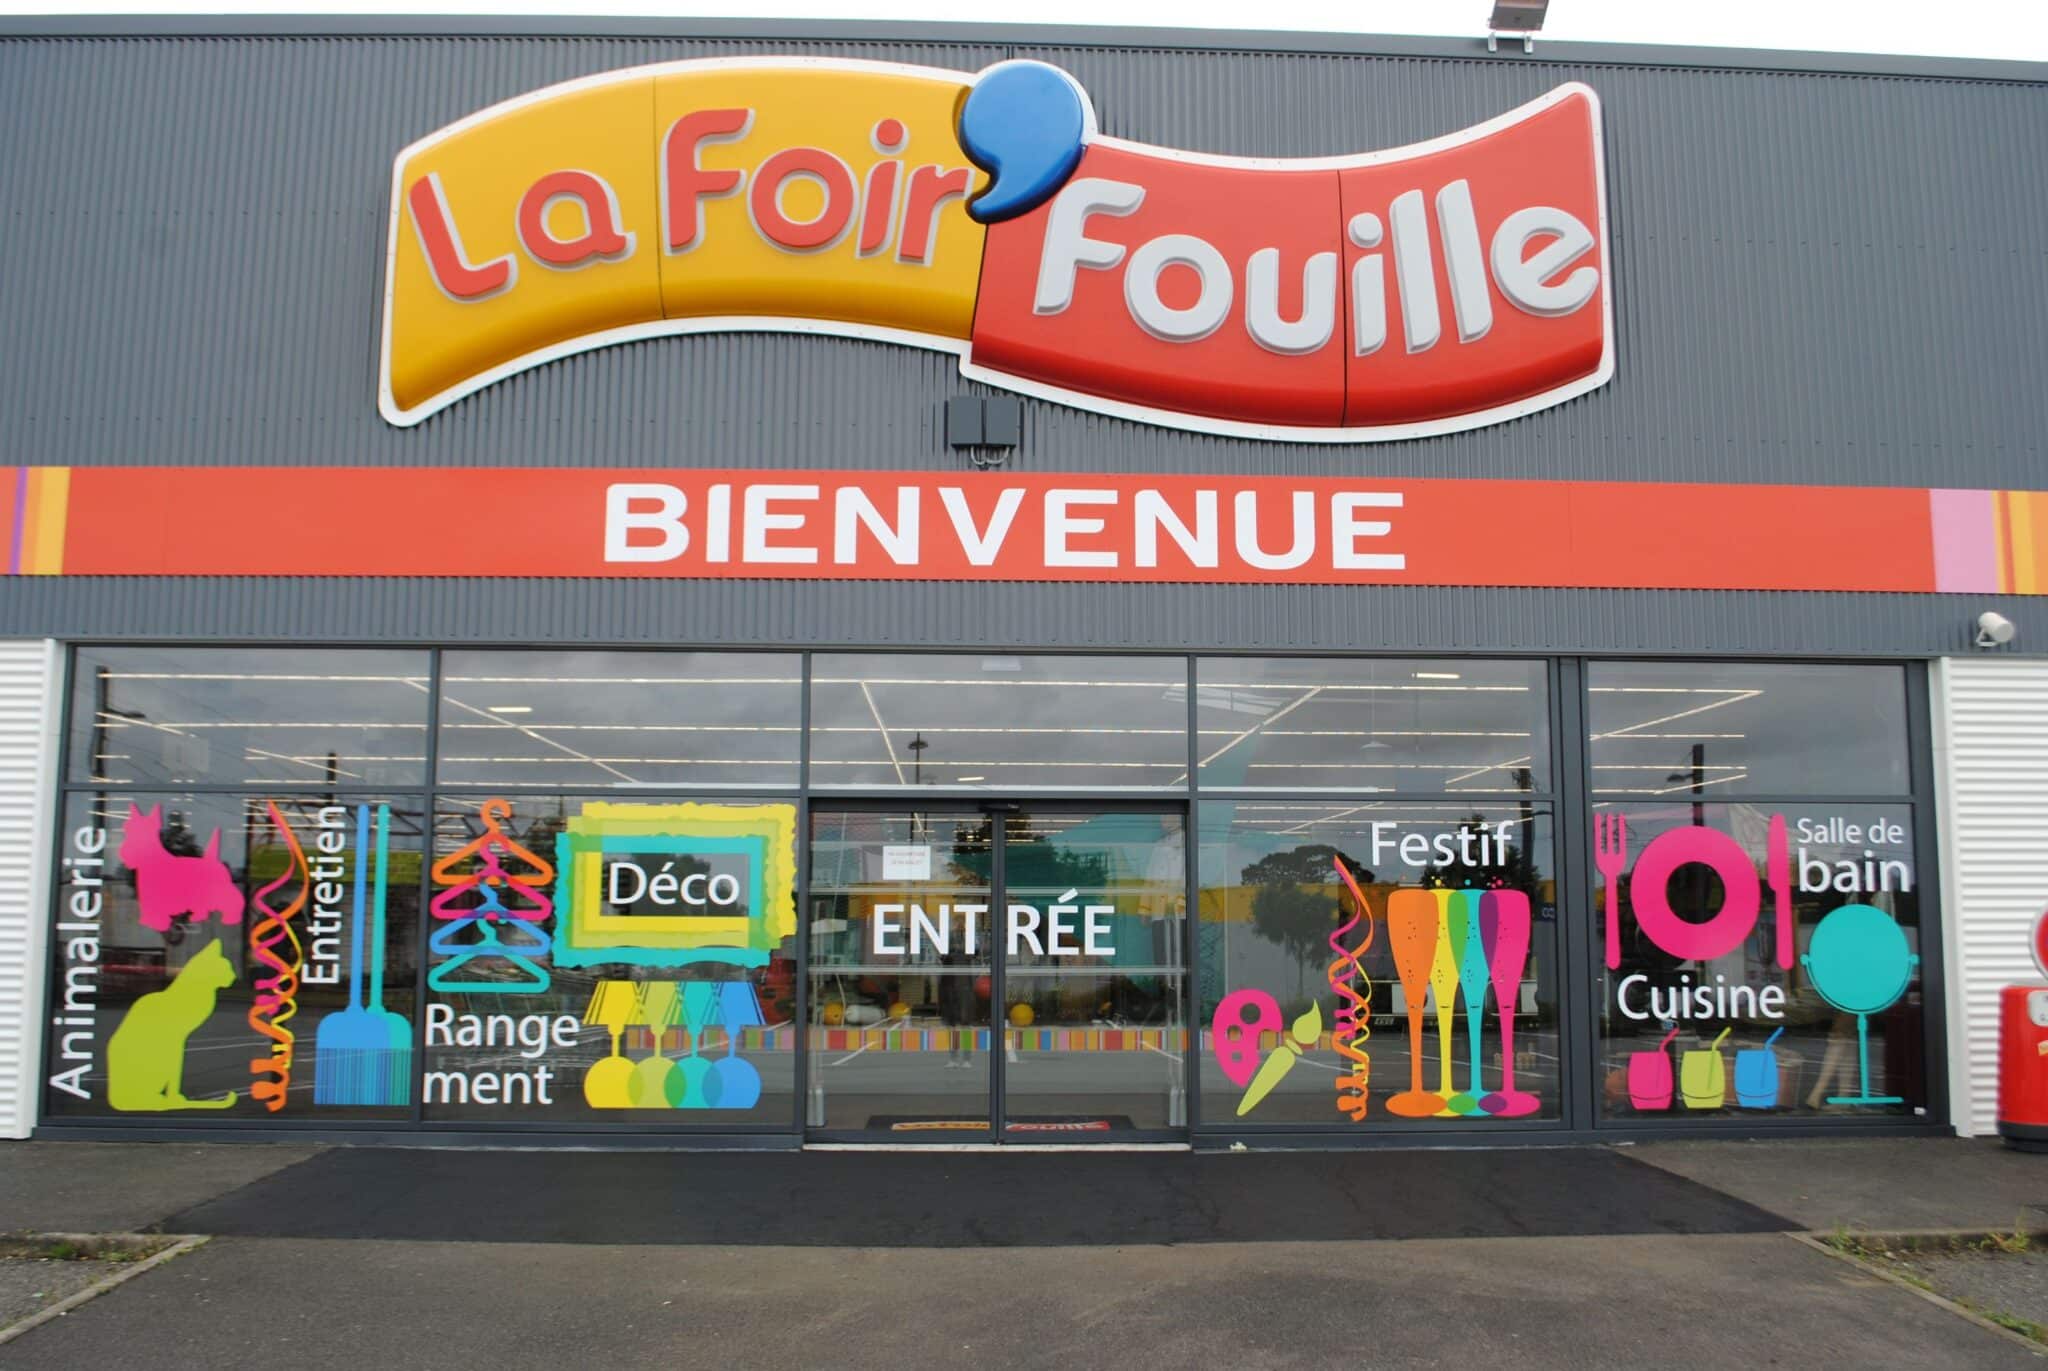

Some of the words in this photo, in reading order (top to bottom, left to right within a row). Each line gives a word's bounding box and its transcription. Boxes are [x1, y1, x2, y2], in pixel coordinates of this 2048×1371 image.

[408, 166, 638, 304] La
[1033, 176, 1602, 356] Fouille
[603, 483, 1406, 573] BIENVENUE
[1371, 821, 1515, 868] Festif
[1797, 817, 1861, 845] Salle
[1867, 818, 1905, 844] de
[608, 861, 740, 908] Déco
[1799, 849, 1912, 893] bain
[303, 805, 347, 986] Entretien
[50, 825, 107, 1100] Animalerie
[1617, 974, 1785, 1021] Cuisine
[424, 1002, 580, 1057] Range
[422, 1065, 554, 1106] ment
